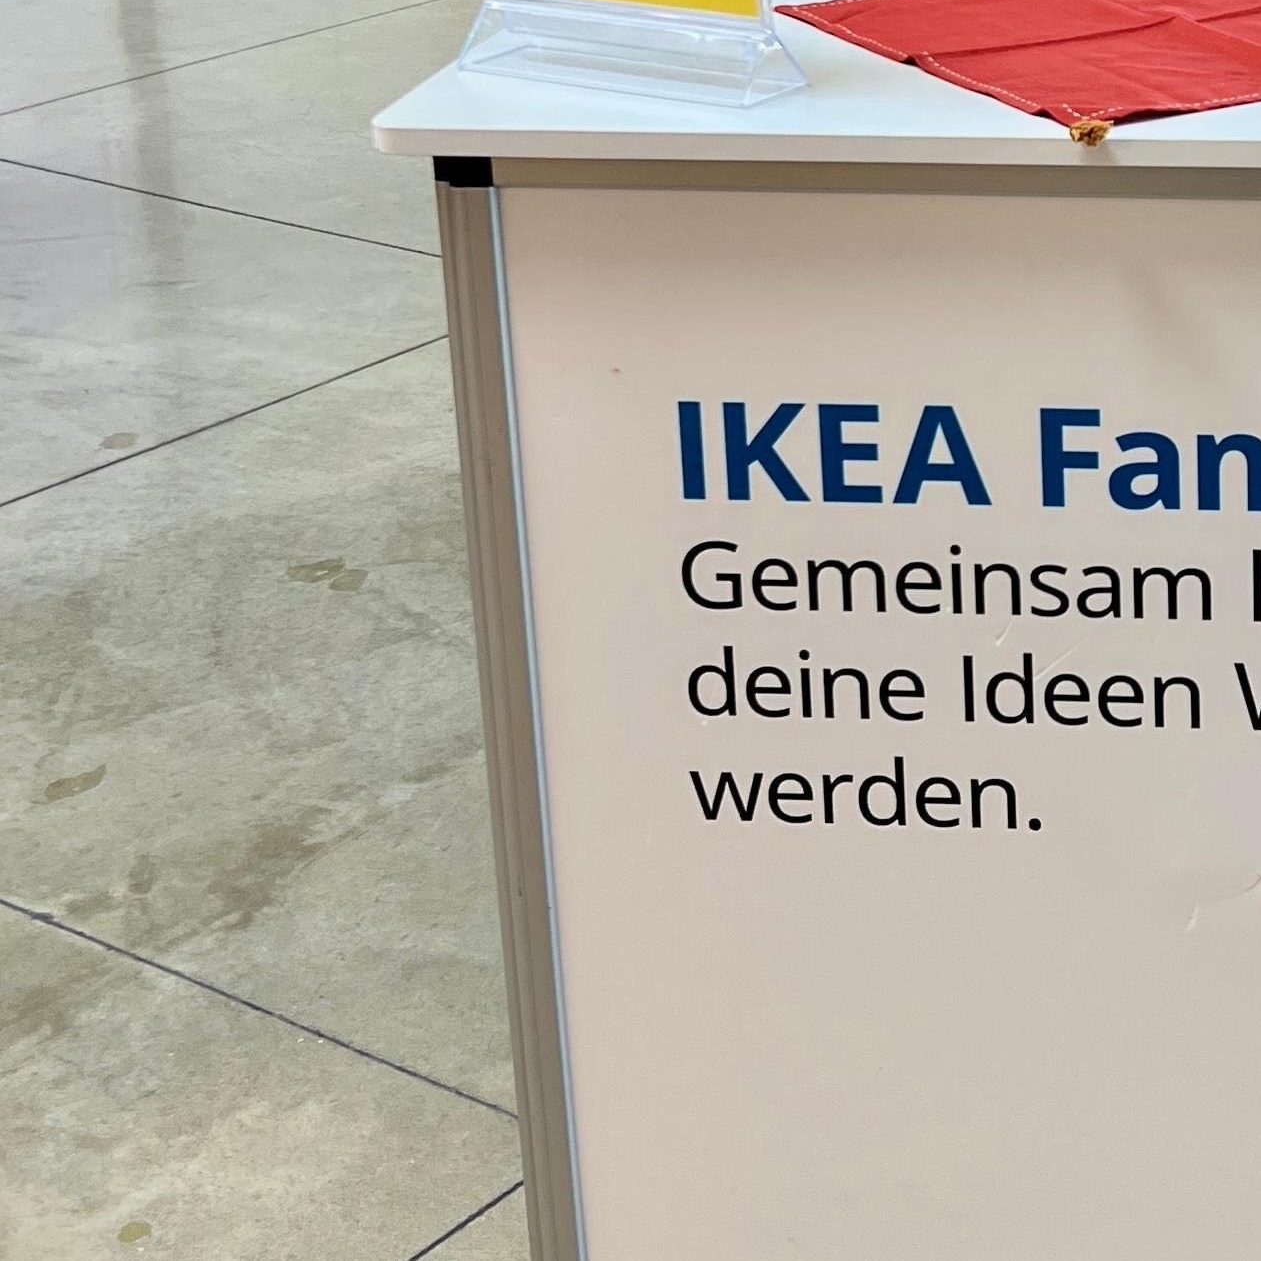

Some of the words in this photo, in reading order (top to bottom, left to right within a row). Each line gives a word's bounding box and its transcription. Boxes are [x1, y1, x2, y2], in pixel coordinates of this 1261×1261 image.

[678, 400, 993, 506] IKEA
[681, 540, 1213, 621] Gemeinsam
[687, 645, 926, 722] deine
[962, 652, 1201, 729] Ideen
[689, 755, 1042, 832] werden.
